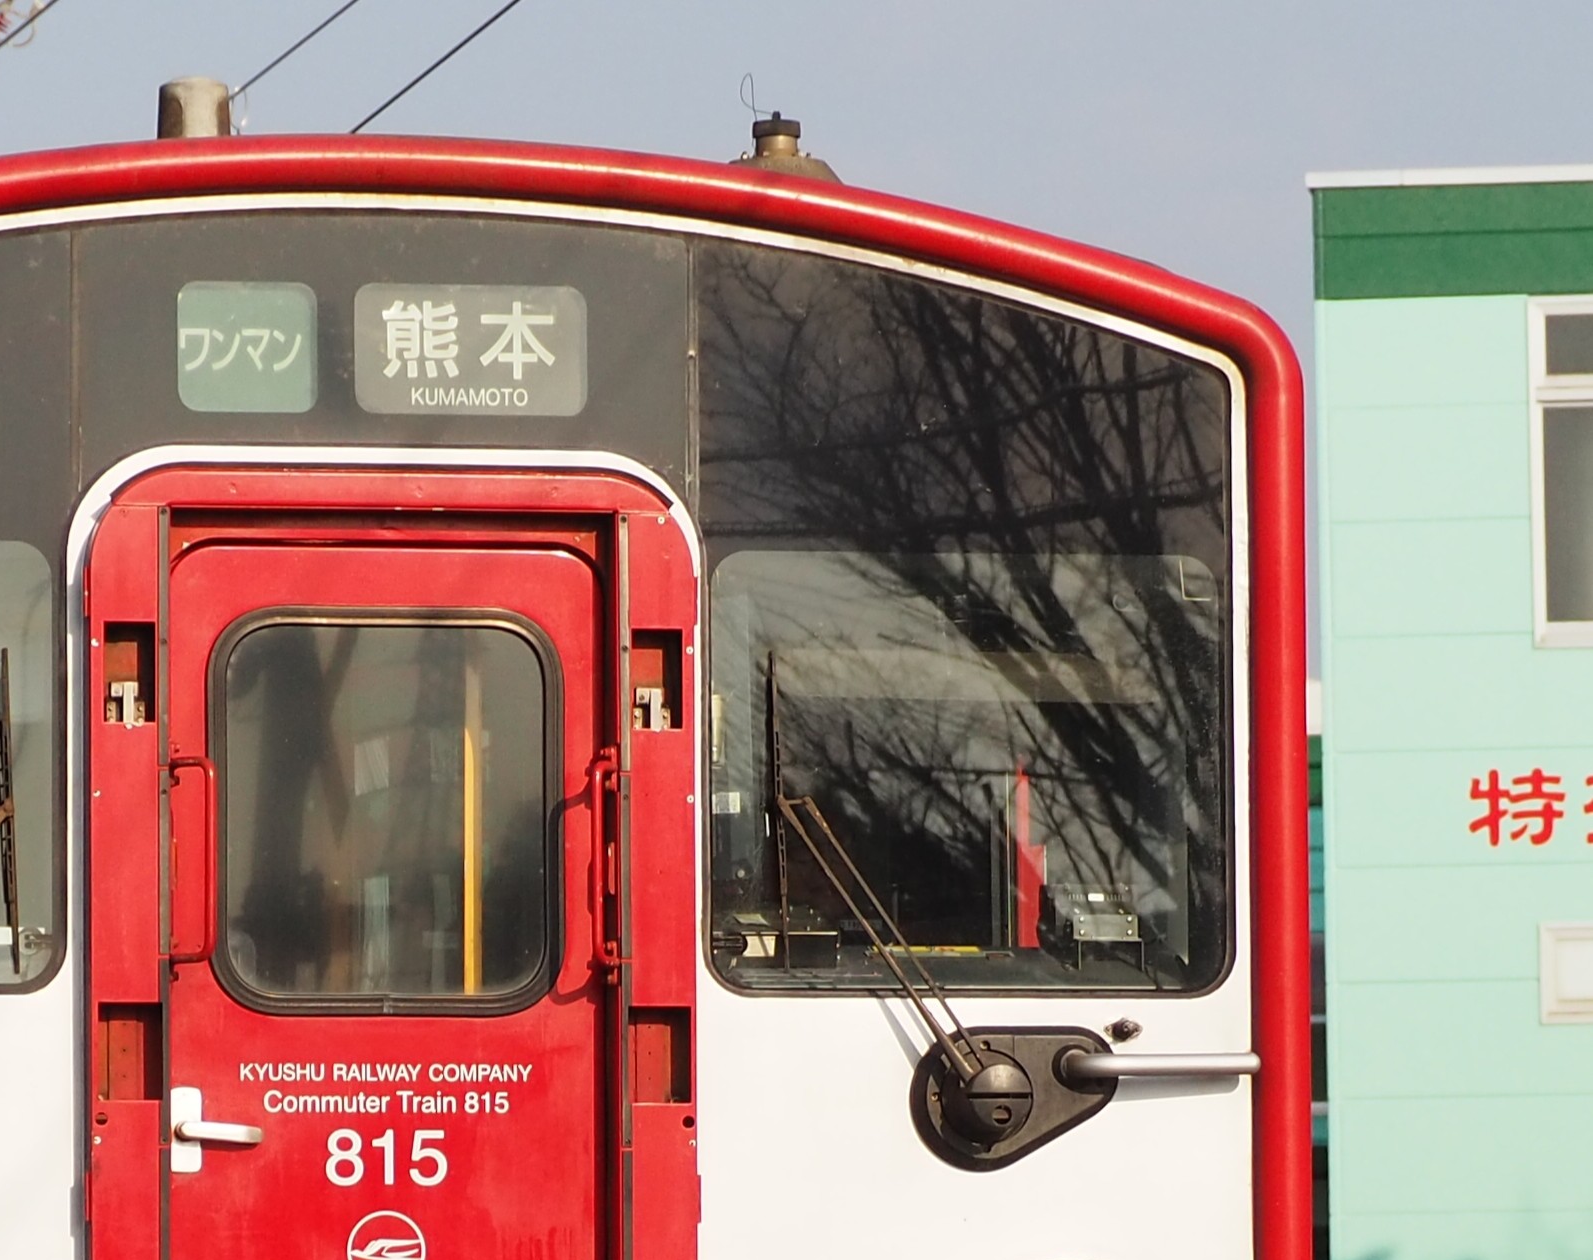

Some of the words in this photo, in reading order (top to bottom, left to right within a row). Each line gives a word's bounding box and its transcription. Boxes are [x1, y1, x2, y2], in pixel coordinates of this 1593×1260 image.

[179, 325, 302, 373] ワンマン
[381, 298, 557, 380] 熊本
[409, 386, 530, 408] KUMAMOTO
[1469, 768, 1593, 847] 特
[239, 1062, 325, 1082] KYUSHU
[332, 1063, 422, 1082] RAILWAY
[428, 1063, 533, 1083] COMPANY
[263, 1089, 390, 1114] Commuter
[395, 1090, 457, 1114] Train
[463, 1091, 510, 1114] 815
[324, 1128, 448, 1187] 815
